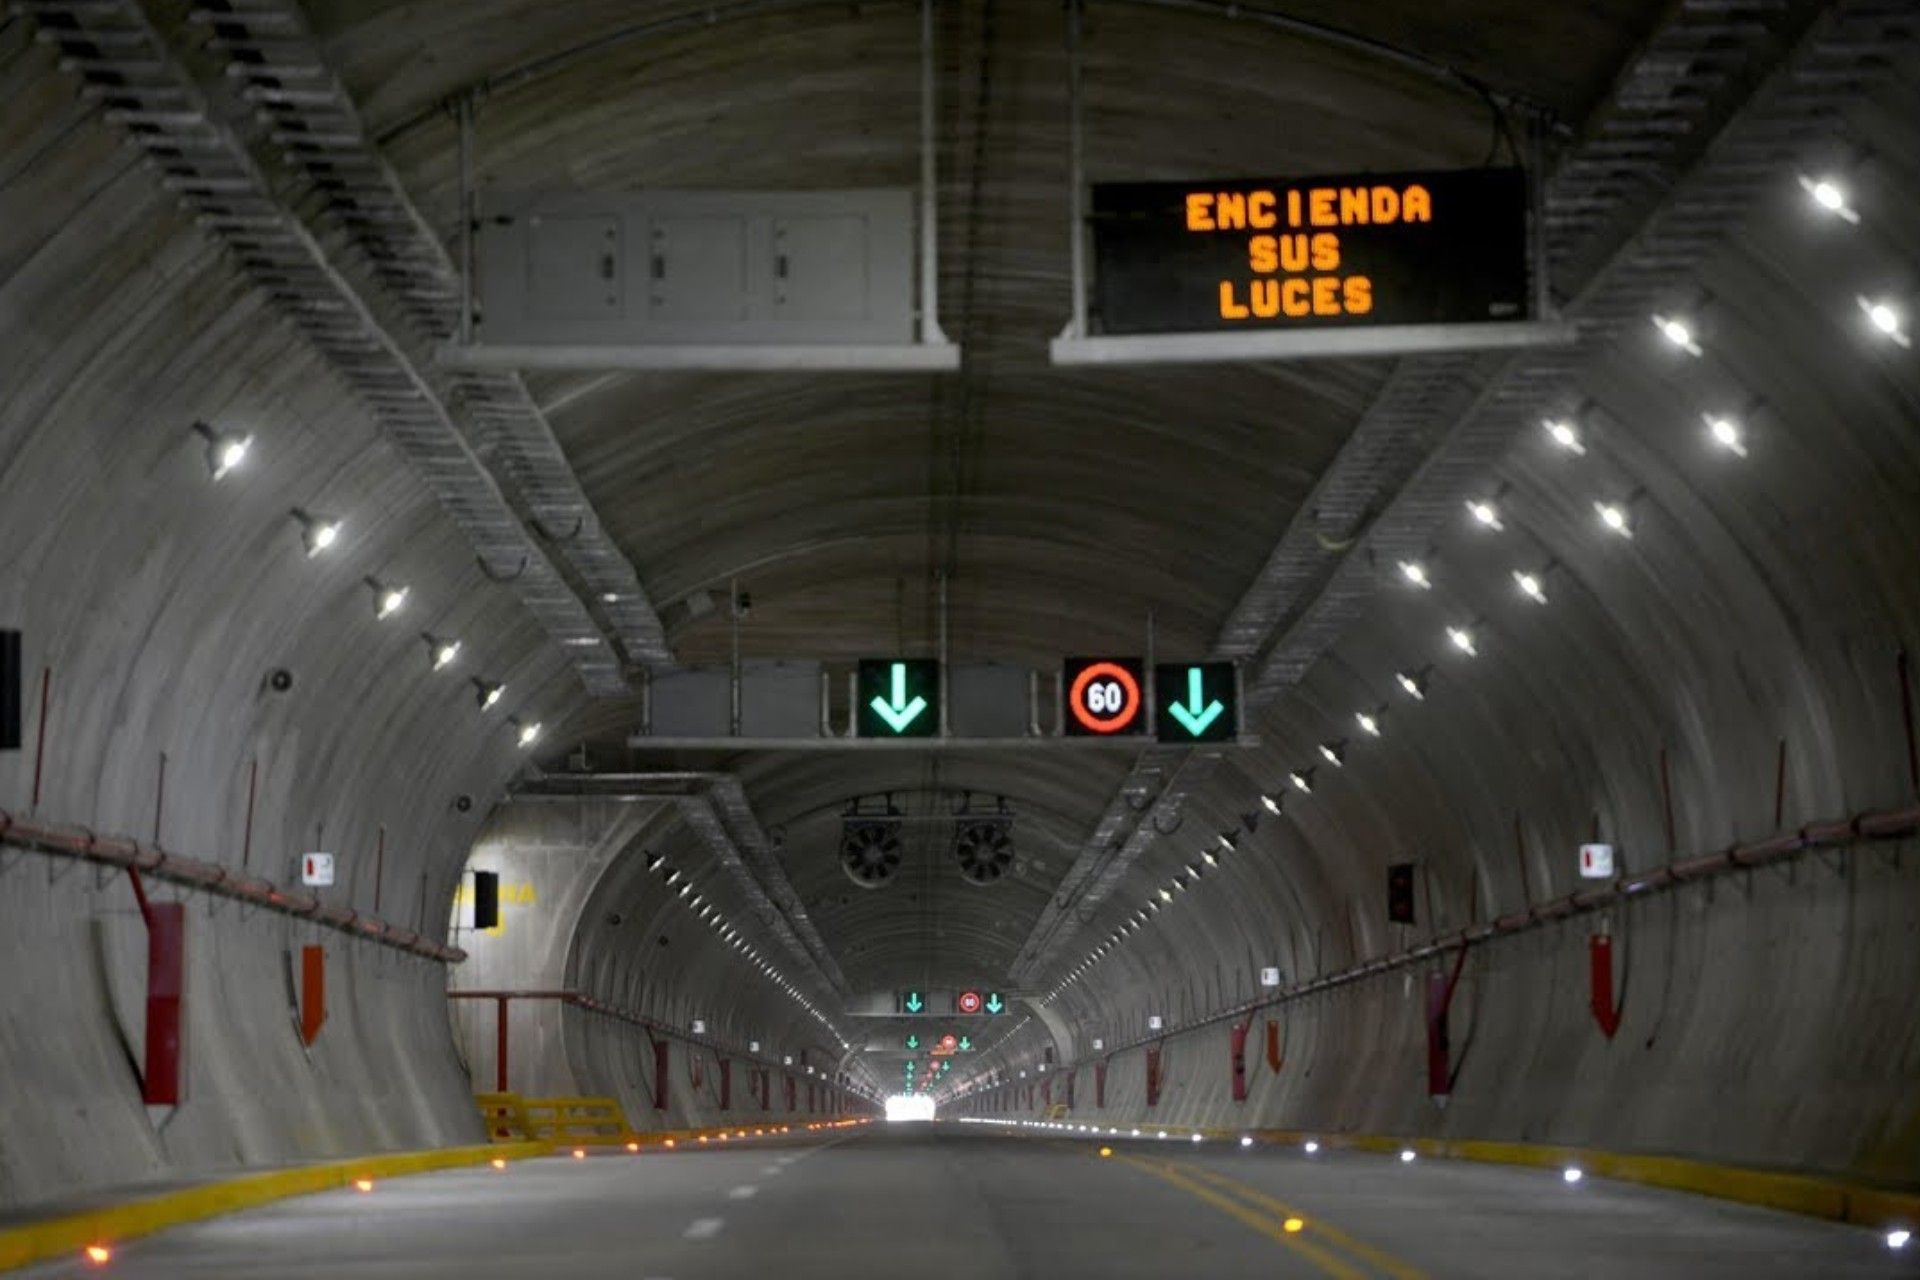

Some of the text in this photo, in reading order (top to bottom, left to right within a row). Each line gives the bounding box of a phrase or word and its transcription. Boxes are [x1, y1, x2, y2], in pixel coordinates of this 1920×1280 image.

[1185, 184, 1432, 232] ENCIENDA
[1248, 232, 1341, 274] SUS
[1219, 275, 1373, 320] LUCES
[1087, 682, 1122, 713] 60
